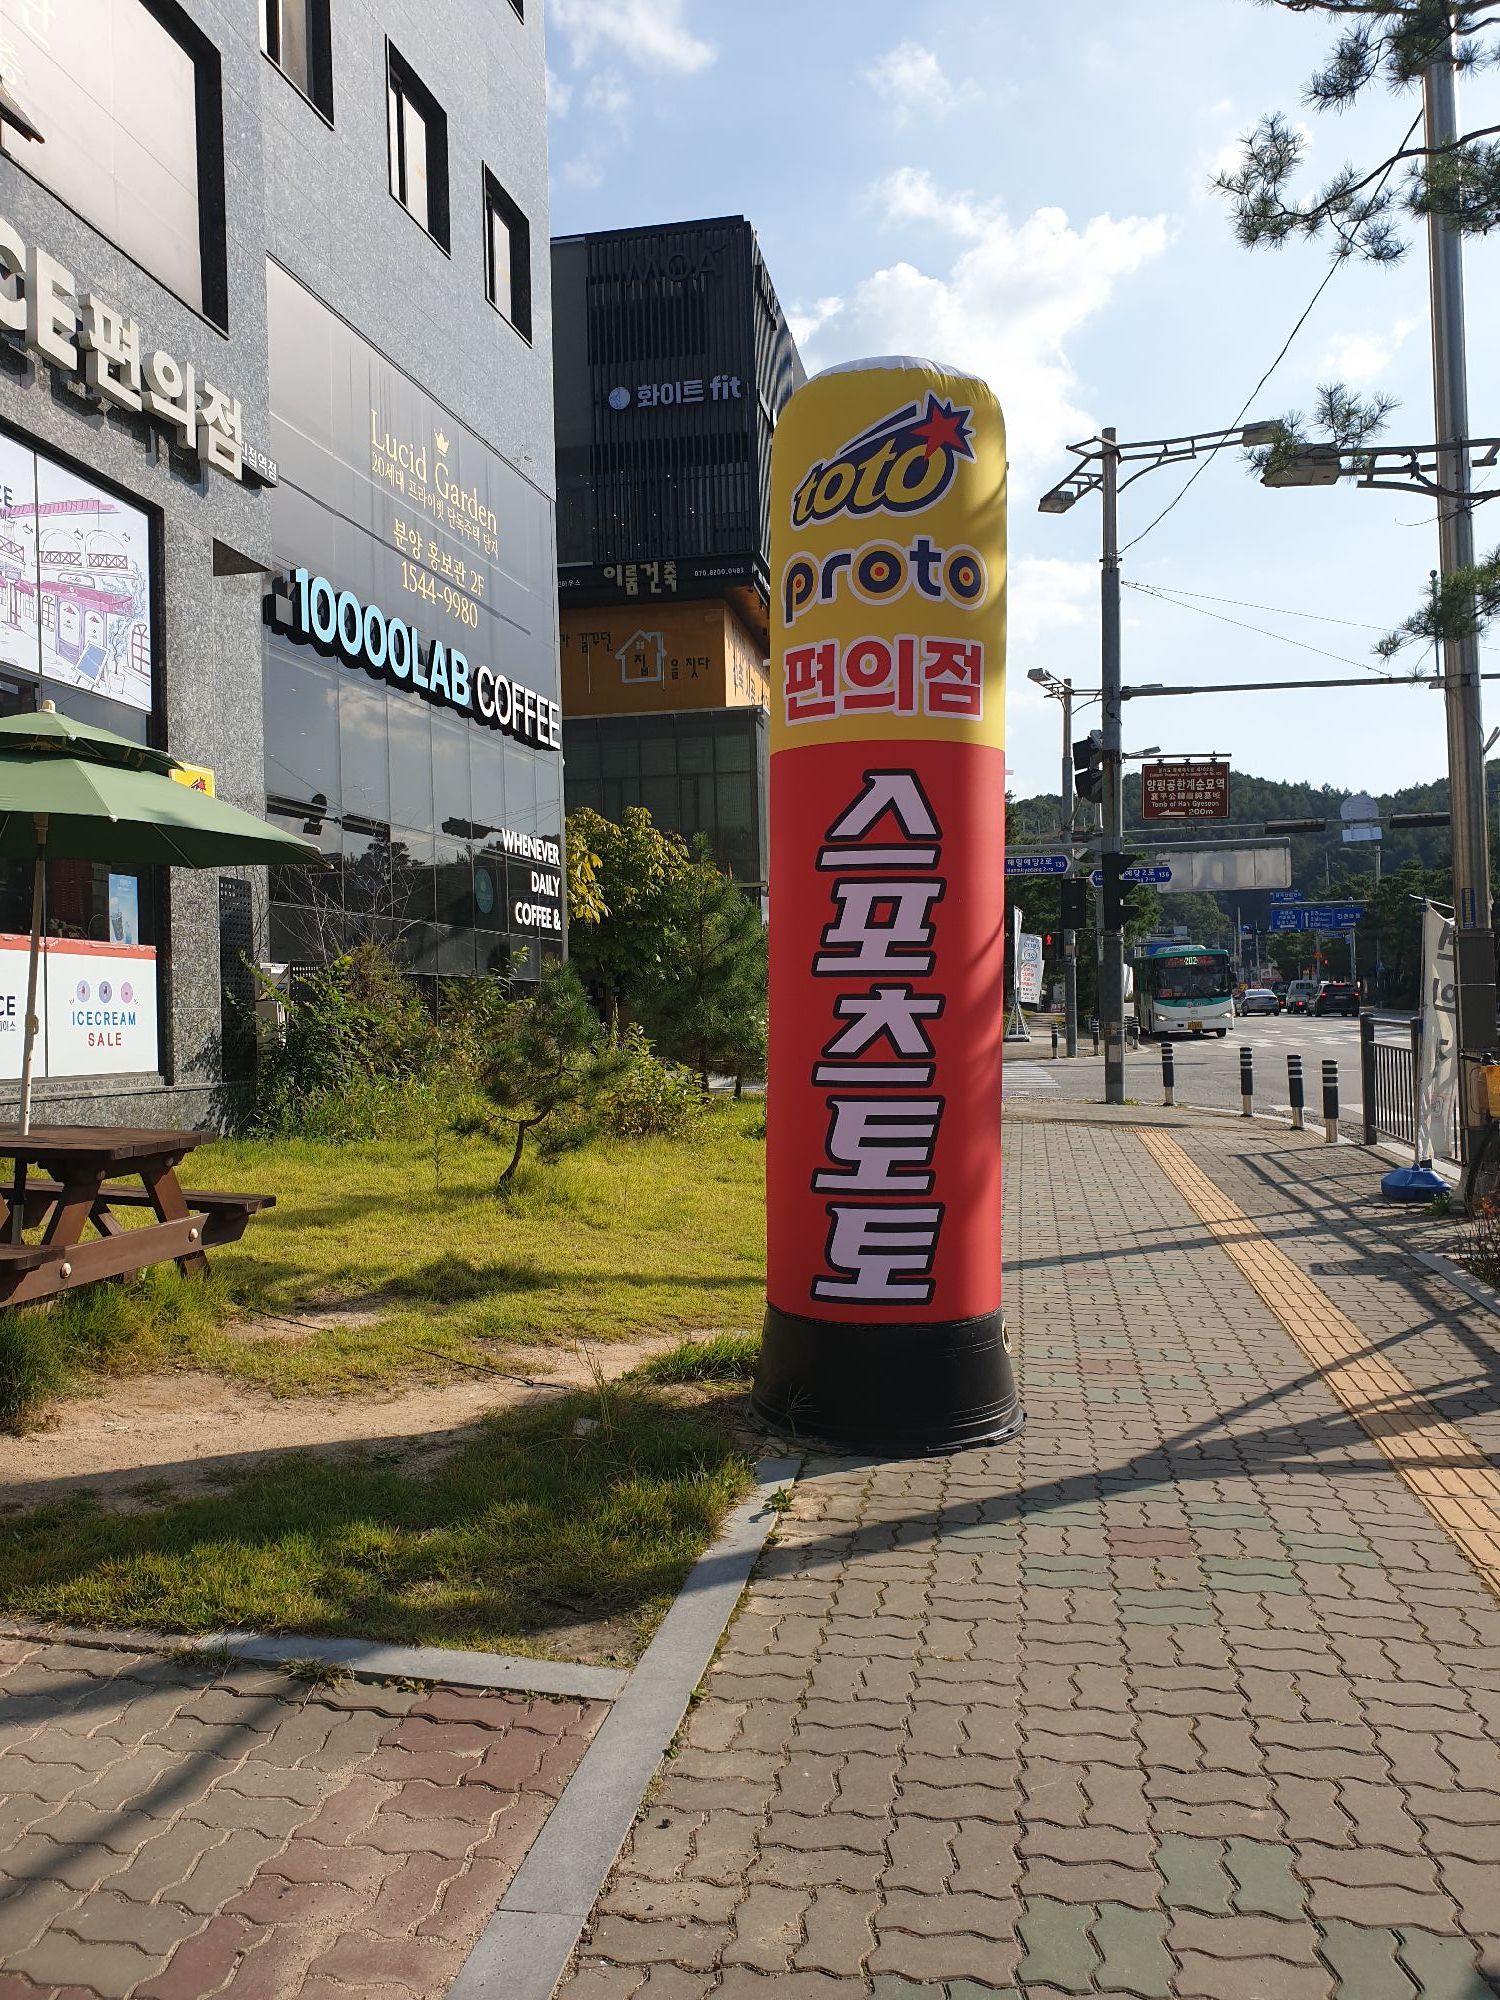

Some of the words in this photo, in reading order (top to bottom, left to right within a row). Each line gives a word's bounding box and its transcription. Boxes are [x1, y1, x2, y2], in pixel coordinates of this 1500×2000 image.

[637, 380, 704, 408] 화이트
[710, 374, 742, 401] fit
[371, 408, 428, 484] Lucid
[435, 462, 498, 536] Garden
[792, 430, 958, 530] toto
[372, 451, 404, 495] 20세대
[447, 507, 480, 548] 단독주택
[483, 533, 499, 561] 단지
[393, 518, 423, 559] 분양
[428, 541, 466, 588] 홍보관
[470, 570, 485, 597] 2F
[694, 567, 745, 577] 070.8200.0483
[401, 561, 478, 629] 1544-9980
[784, 538, 986, 624] proto
[295, 567, 471, 707] 10000LAB
[476, 665, 561, 750] COFFEE
[577, 631, 614, 654] 꿈꾸던
[784, 637, 982, 722] 편의점
[1147, 778, 1225, 791] 양평공한계순묘역
[501, 827, 561, 865] WHENEVER
[531, 870, 560, 897] DAILY
[515, 902, 552, 929] COFFEE
[553, 908, 561, 931] &
[1185, 957, 1197, 965] 202
[72, 1010, 136, 1026] ICECREAM
[811, 771, 946, 1303] 스포츠토토
[88, 1032, 122, 1047] SALE
